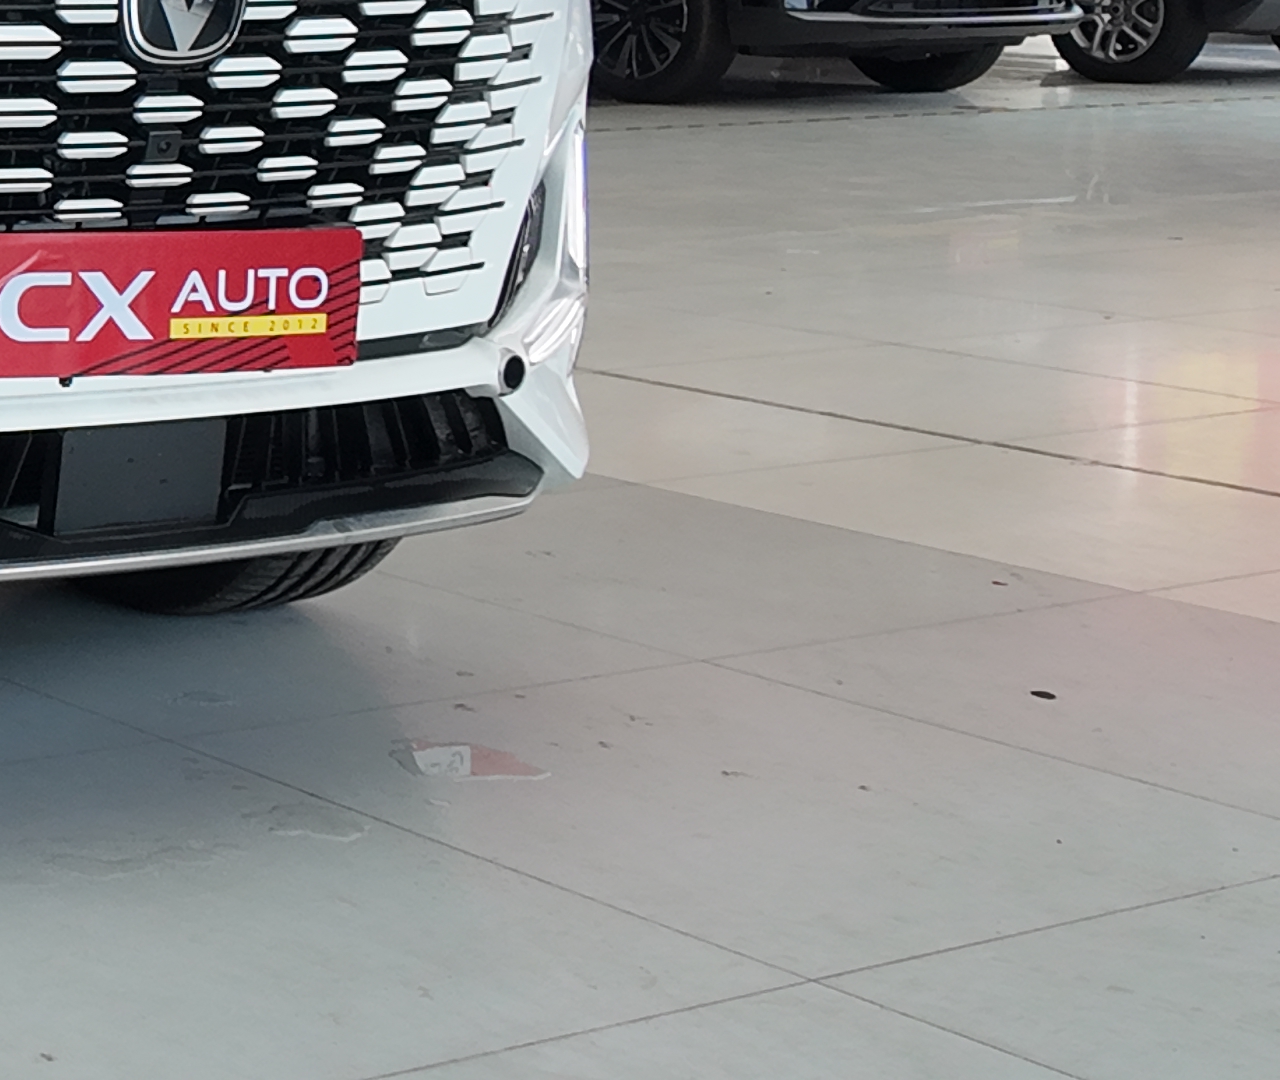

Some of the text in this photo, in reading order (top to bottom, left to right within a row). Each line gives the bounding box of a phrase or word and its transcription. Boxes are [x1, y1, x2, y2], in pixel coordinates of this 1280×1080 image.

[171, 267, 329, 312] AUTO
[182, 317, 320, 336] SINCE 2012
